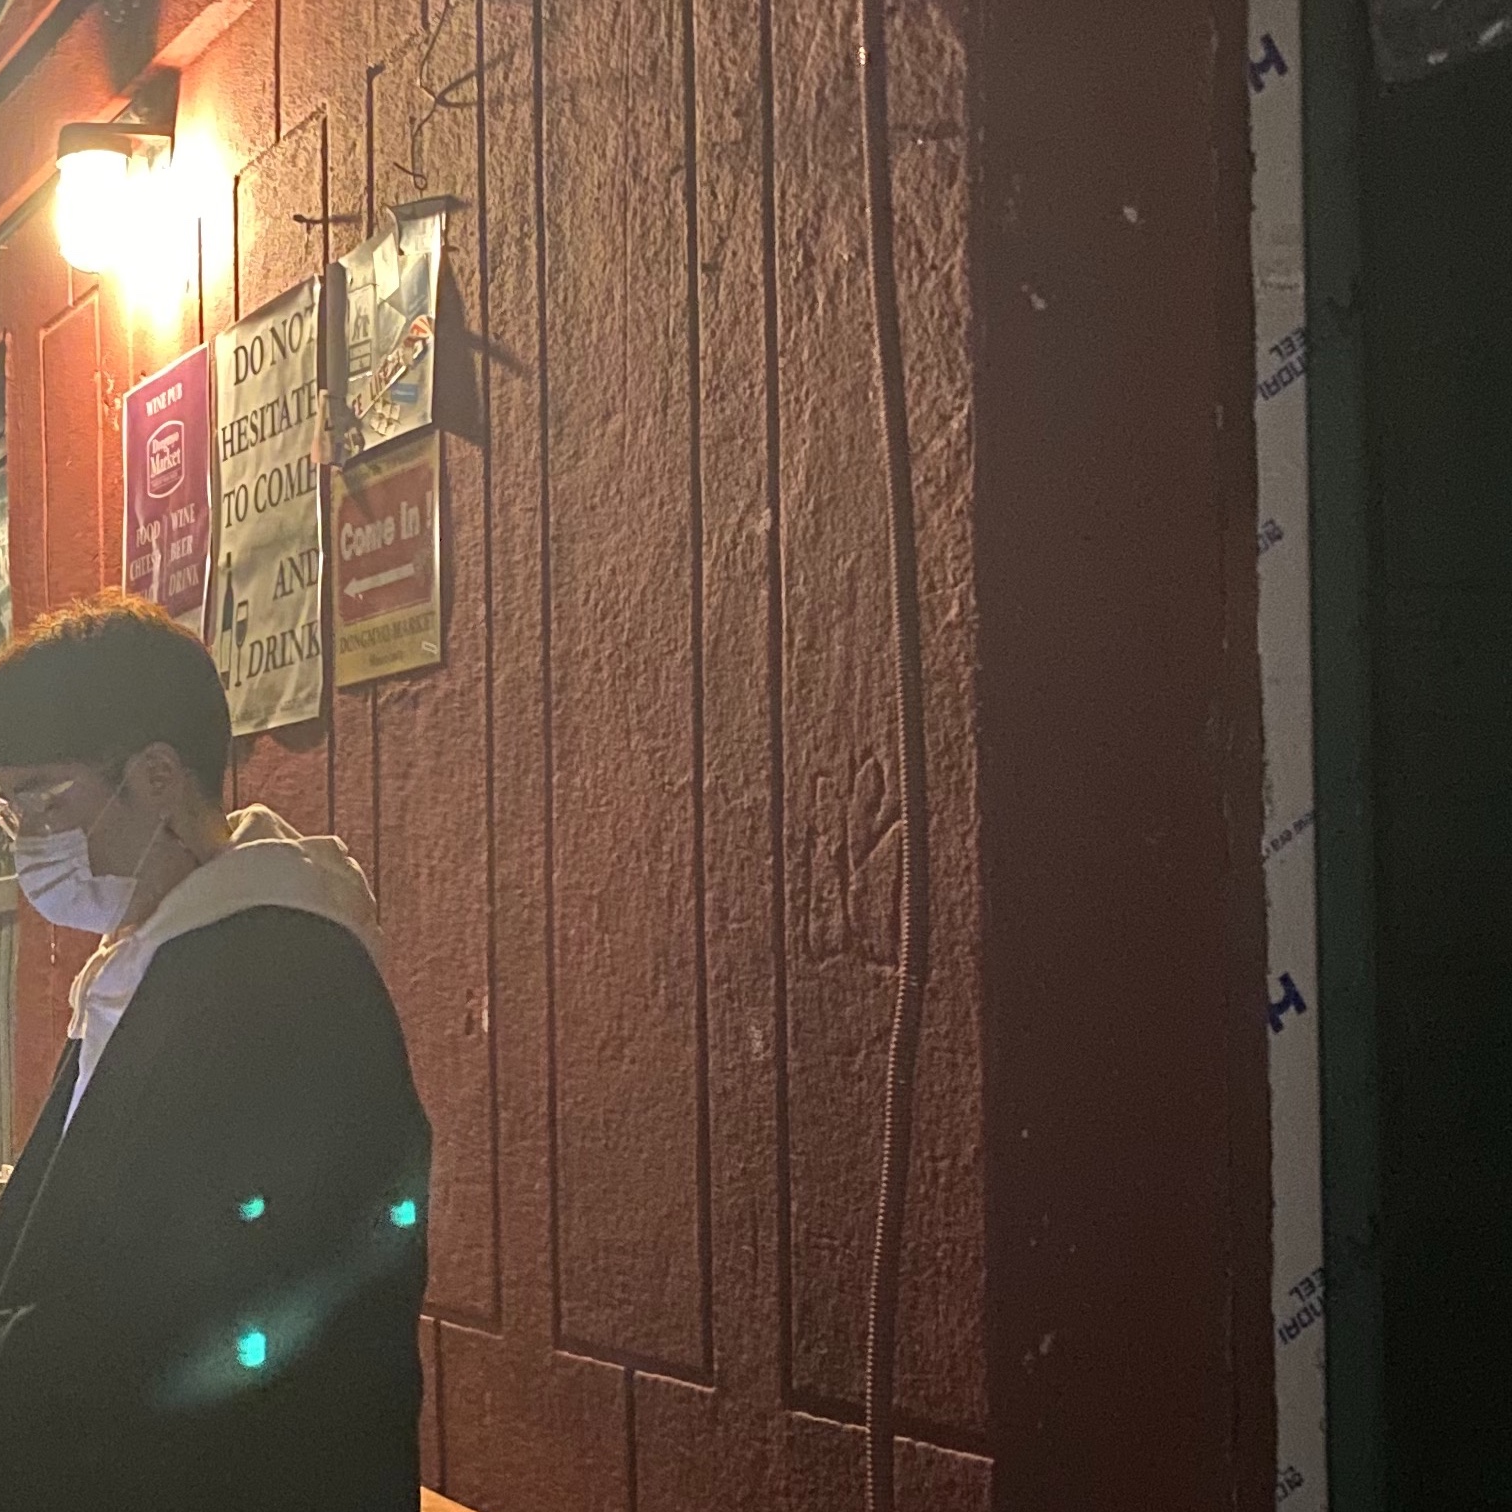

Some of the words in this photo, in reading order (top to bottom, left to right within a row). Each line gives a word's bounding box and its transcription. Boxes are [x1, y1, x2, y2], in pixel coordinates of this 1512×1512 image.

[234, 336, 264, 386] DO
[270, 304, 316, 366] NOT
[146, 392, 167, 417] WINE
[167, 382, 183, 406] PUB
[222, 380, 317, 462] HESITATE
[150, 448, 180, 478] Market
[223, 484, 249, 528] TO
[254, 454, 317, 514] COME
[136, 520, 160, 547] FOOD
[171, 503, 195, 531] WINE
[171, 535, 193, 561] BEER
[340, 515, 395, 561] Come
[168, 563, 199, 596] DRINK
[273, 548, 319, 600] AND
[246, 620, 320, 679] DRINK
